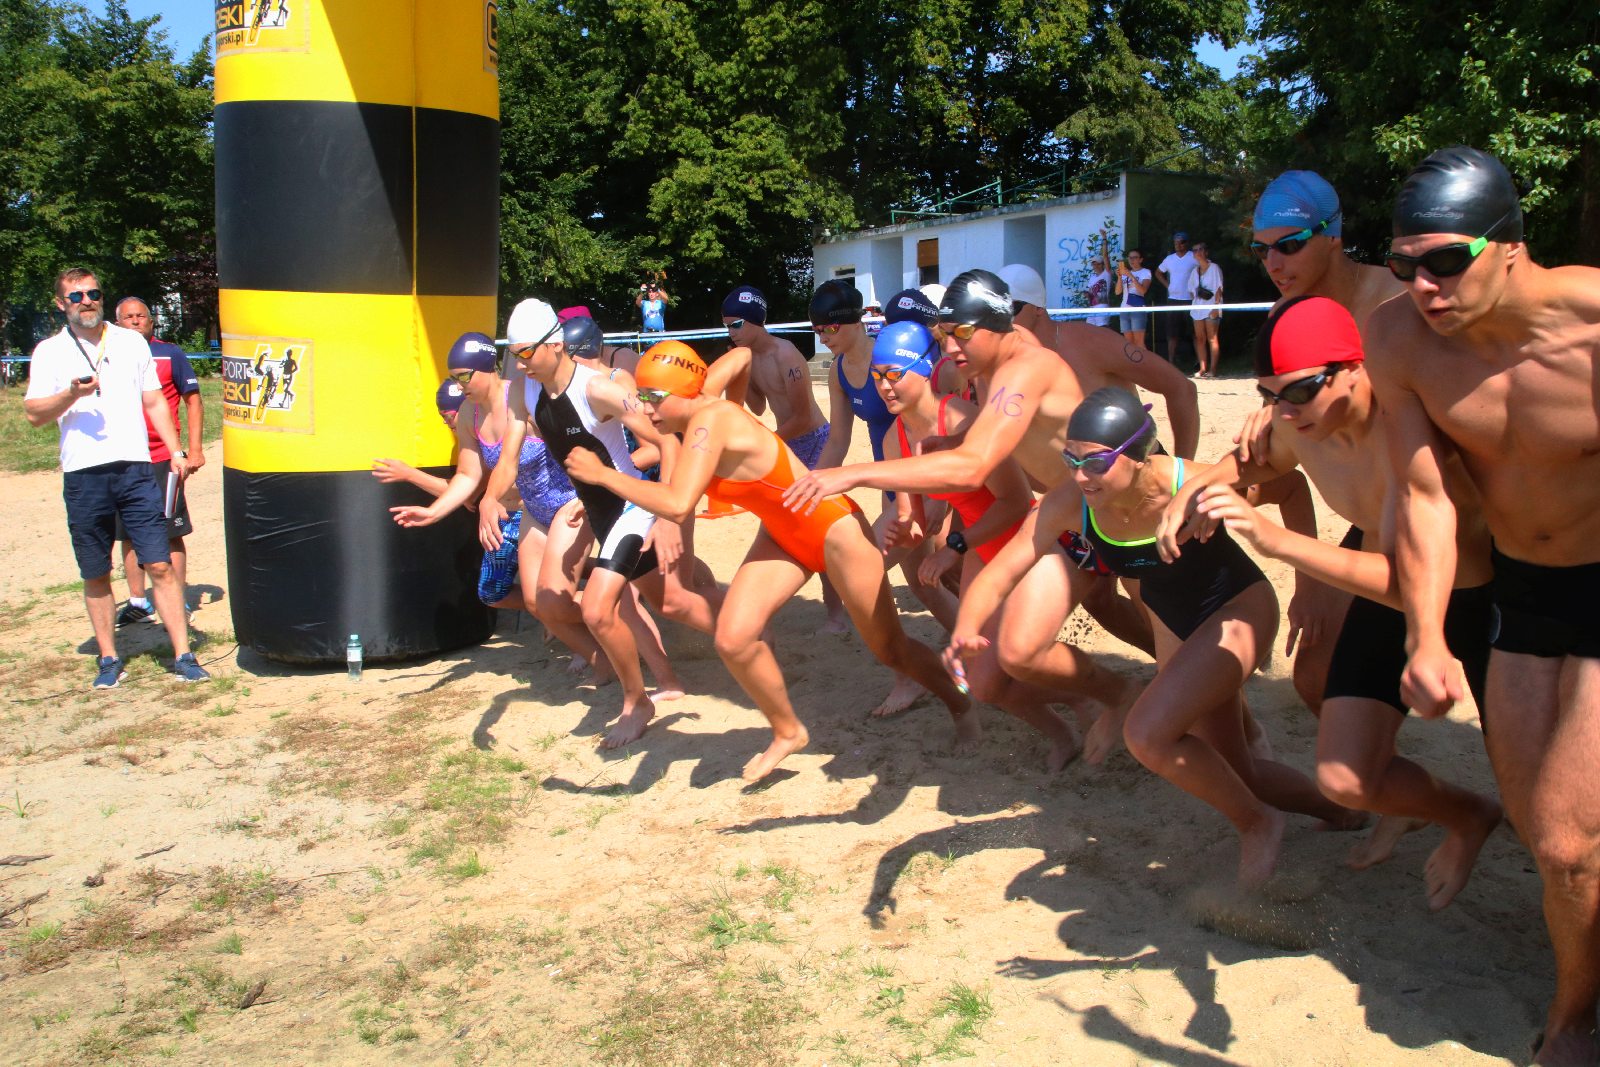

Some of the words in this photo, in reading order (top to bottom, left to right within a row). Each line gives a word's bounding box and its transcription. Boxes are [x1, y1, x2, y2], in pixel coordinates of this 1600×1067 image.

[895, 348, 922, 361] aren
[991, 386, 1025, 417] 16
[691, 427, 709, 451] 2
